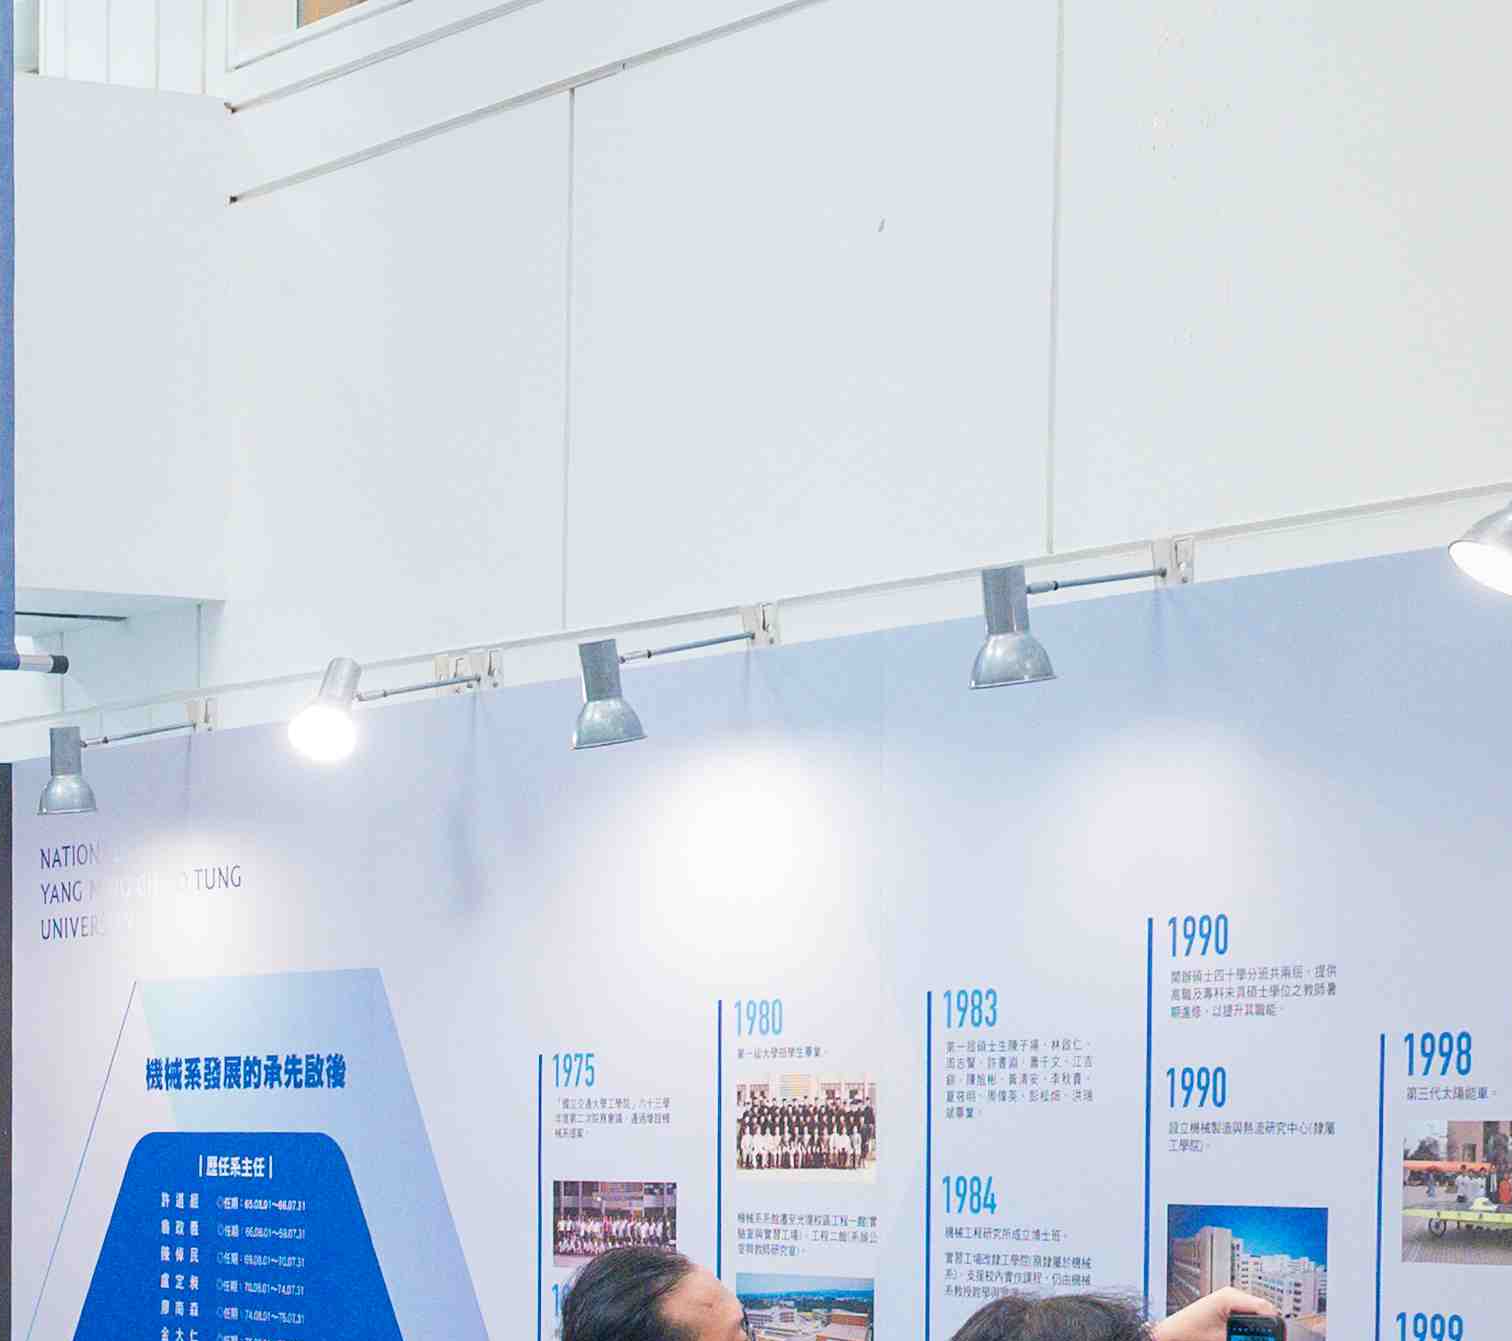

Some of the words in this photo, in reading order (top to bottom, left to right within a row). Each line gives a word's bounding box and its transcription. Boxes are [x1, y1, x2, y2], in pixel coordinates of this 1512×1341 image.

[1168, 913, 1229, 957] 1990
[734, 999, 784, 1038] 1980
[942, 989, 998, 1029] 1983
[552, 1053, 596, 1089] 1975
[1404, 1031, 1472, 1077] 1998
[1167, 1066, 1226, 1108] 1990
[942, 1175, 998, 1215] 1984
